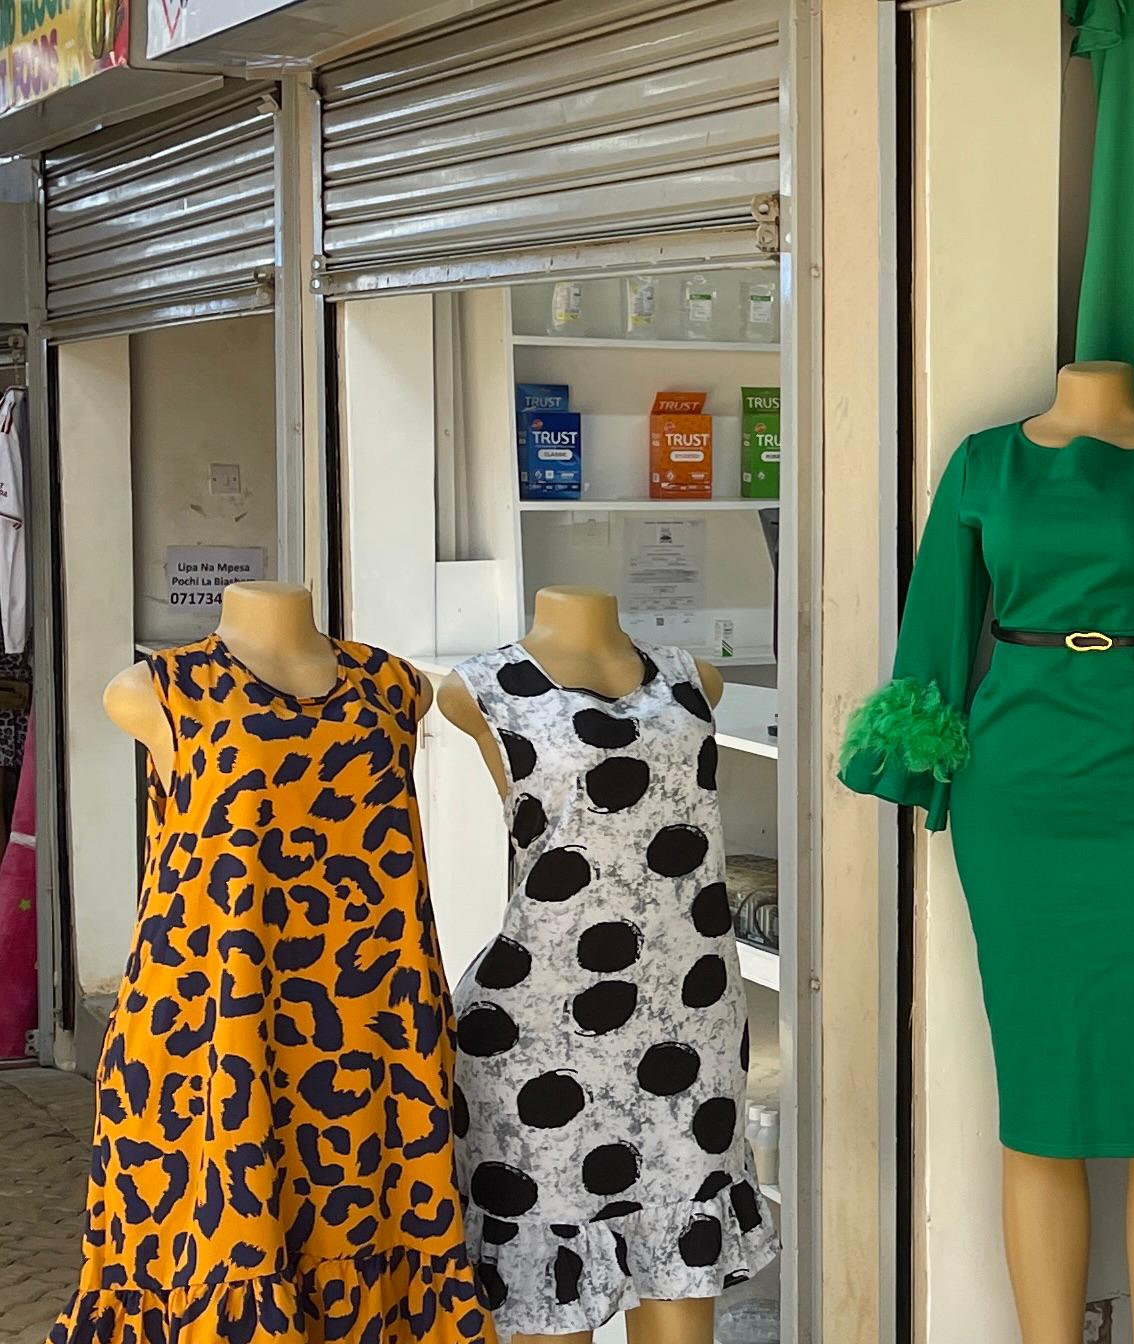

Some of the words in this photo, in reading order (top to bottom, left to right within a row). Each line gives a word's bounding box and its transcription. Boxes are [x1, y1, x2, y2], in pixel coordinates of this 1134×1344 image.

[524, 396, 562, 408] TRUST
[658, 400, 700, 412] TRUST
[746, 396, 780, 409] TRUS
[532, 431, 578, 445] TRUST
[665, 433, 709, 446] TRUST
[178, 563, 198, 574] Lipa
[201, 563, 215, 572] Na
[217, 563, 250, 574] Mpesa
[172, 577, 199, 586] Pochi
[202, 578, 212, 586] La
